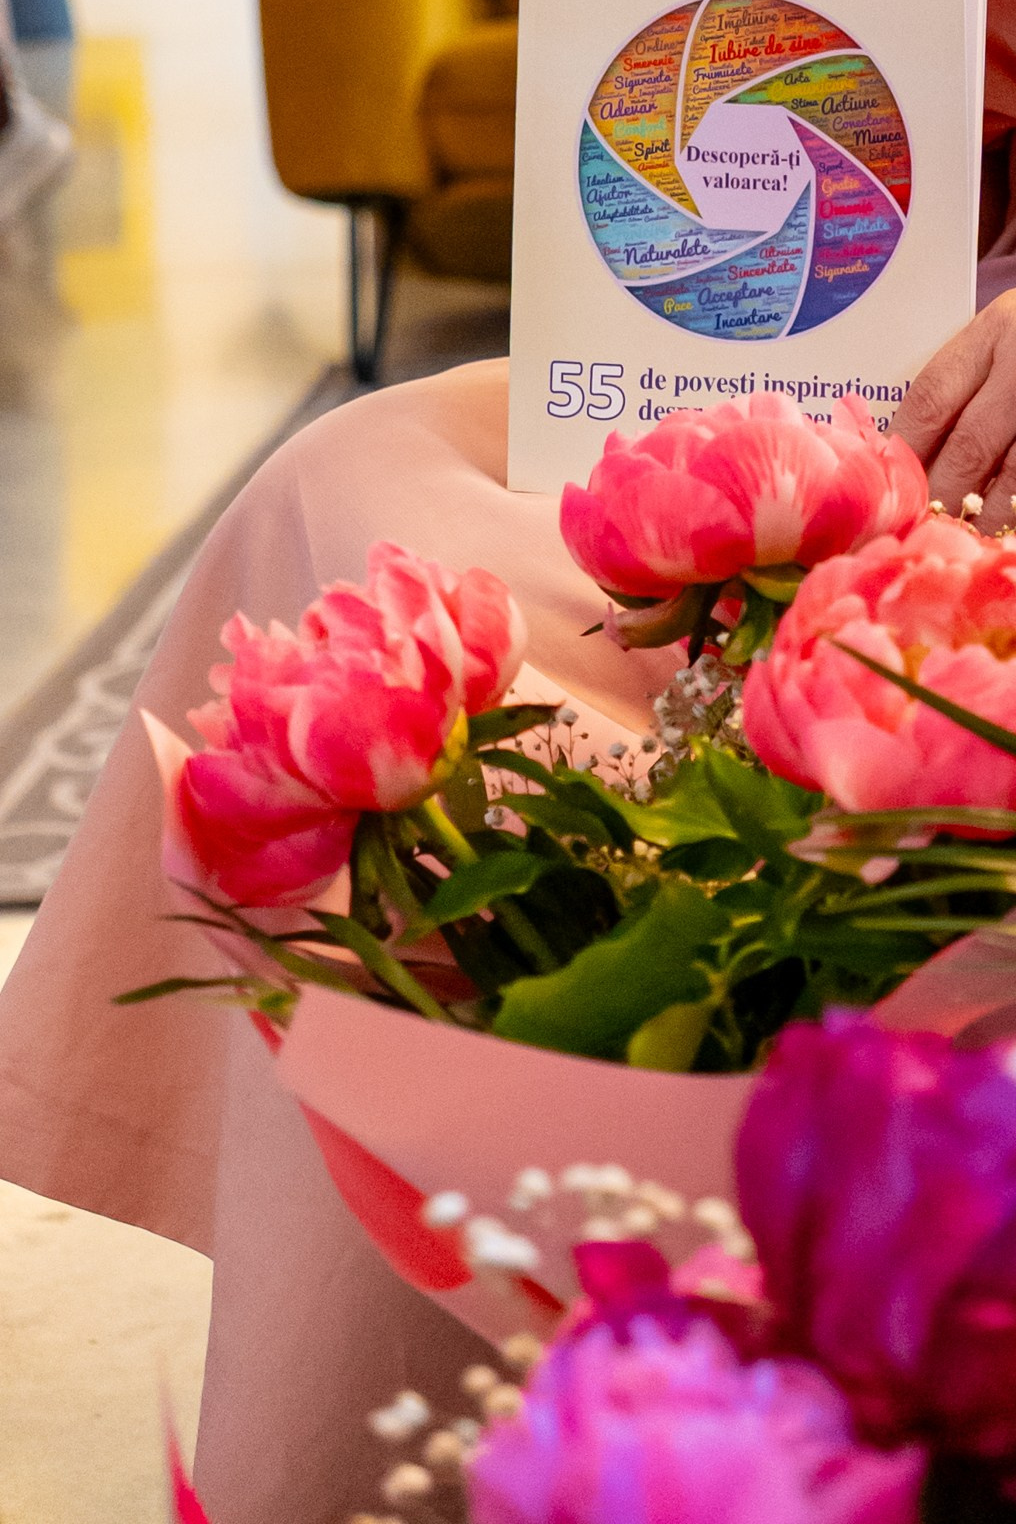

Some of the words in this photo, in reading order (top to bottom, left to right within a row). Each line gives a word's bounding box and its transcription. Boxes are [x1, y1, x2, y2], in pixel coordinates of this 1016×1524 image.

[716, 9, 780, 35] Implinire
[709, 39, 762, 64] Iubire
[764, 33, 786, 56] de
[788, 35, 823, 54] sine
[614, 69, 673, 94] Siguranta
[784, 71, 811, 86] Arta
[600, 98, 659, 121] Adevar
[821, 93, 880, 116] Actiune
[832, 111, 893, 132] Conectare
[853, 128, 904, 146] Munca
[634, 138, 672, 160] Spirit
[702, 172, 788, 192] valoarea!
[586, 186, 633, 207] Ajutor
[623, 238, 711, 266] Naturalete
[759, 245, 804, 260] Altruism
[727, 259, 798, 281] Sinceritate
[814, 259, 870, 283] Siguranta
[663, 295, 694, 315] Pace
[697, 281, 776, 308] Acceptare
[713, 308, 783, 330] Incantare
[547, 360, 626, 421] 55
[639, 367, 667, 390] de
